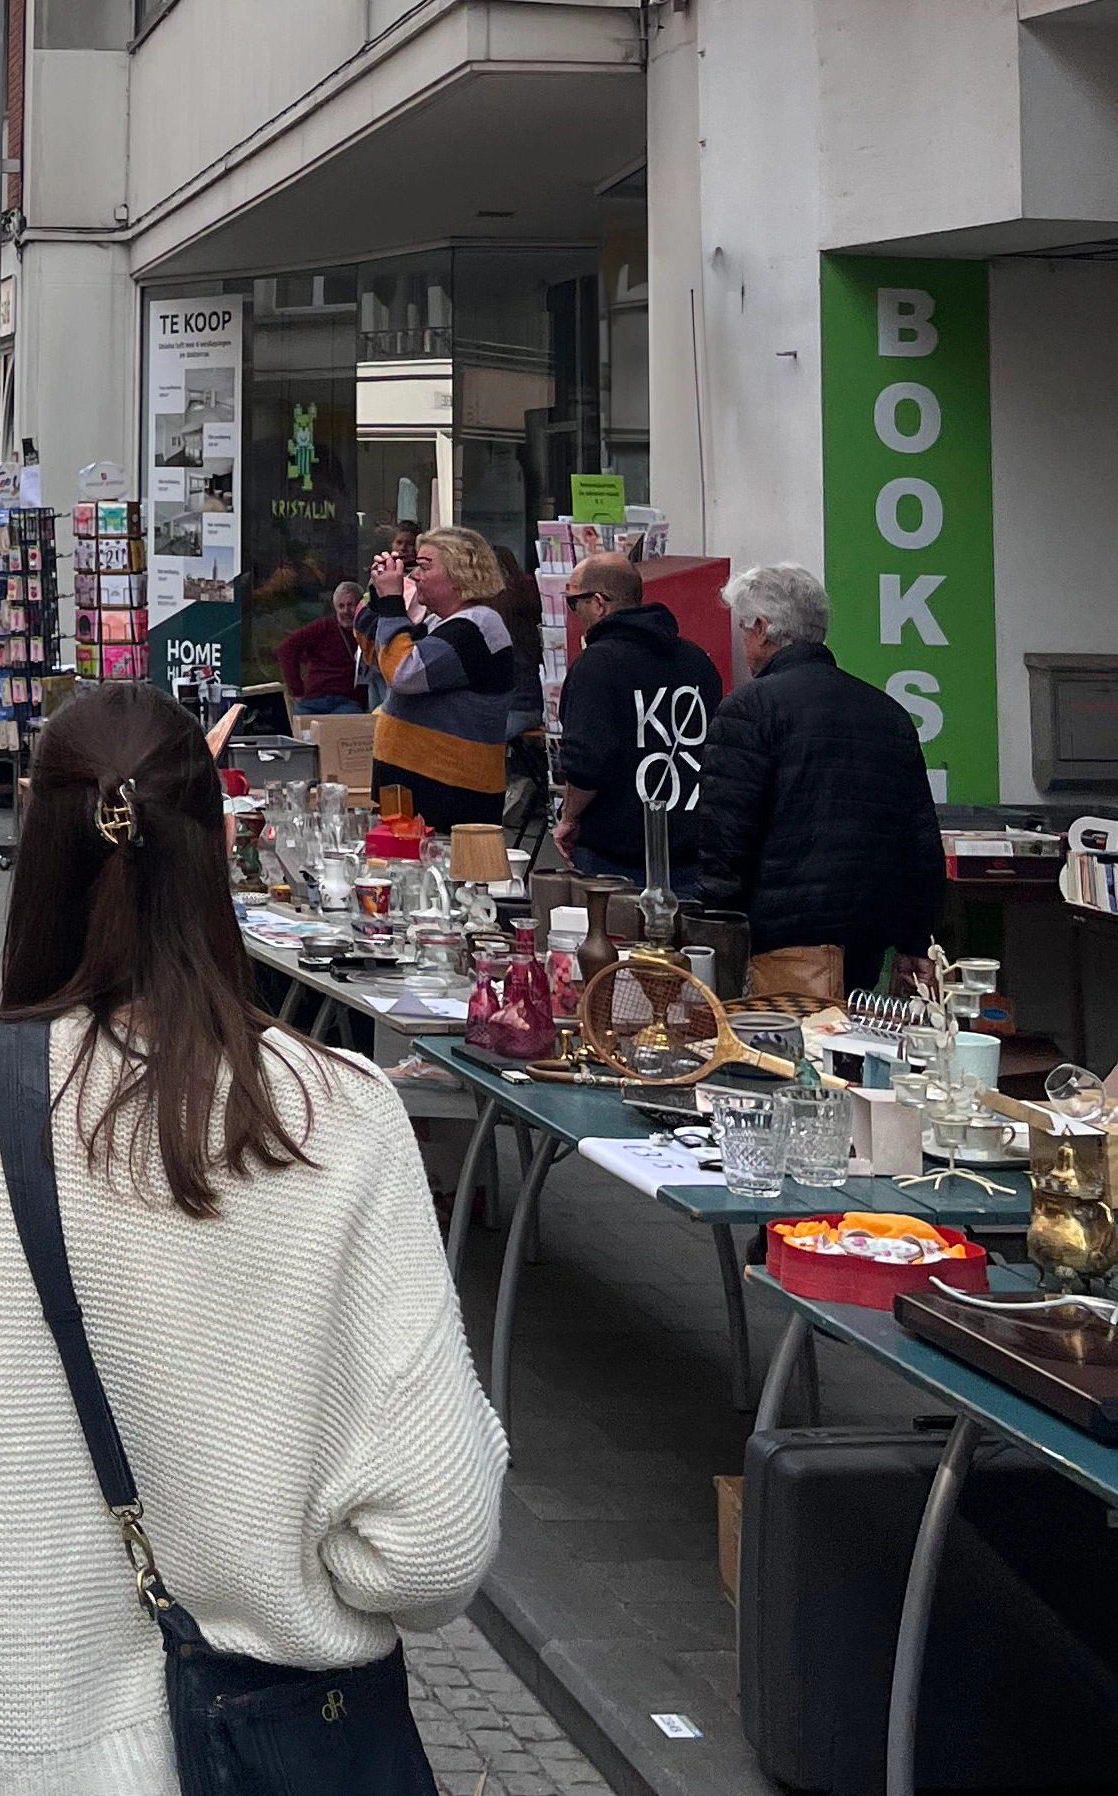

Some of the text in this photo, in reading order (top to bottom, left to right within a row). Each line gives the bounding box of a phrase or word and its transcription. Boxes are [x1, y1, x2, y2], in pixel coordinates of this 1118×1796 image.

[160, 311, 232, 334] TE KOOP
[167, 639, 221, 667] HOME
